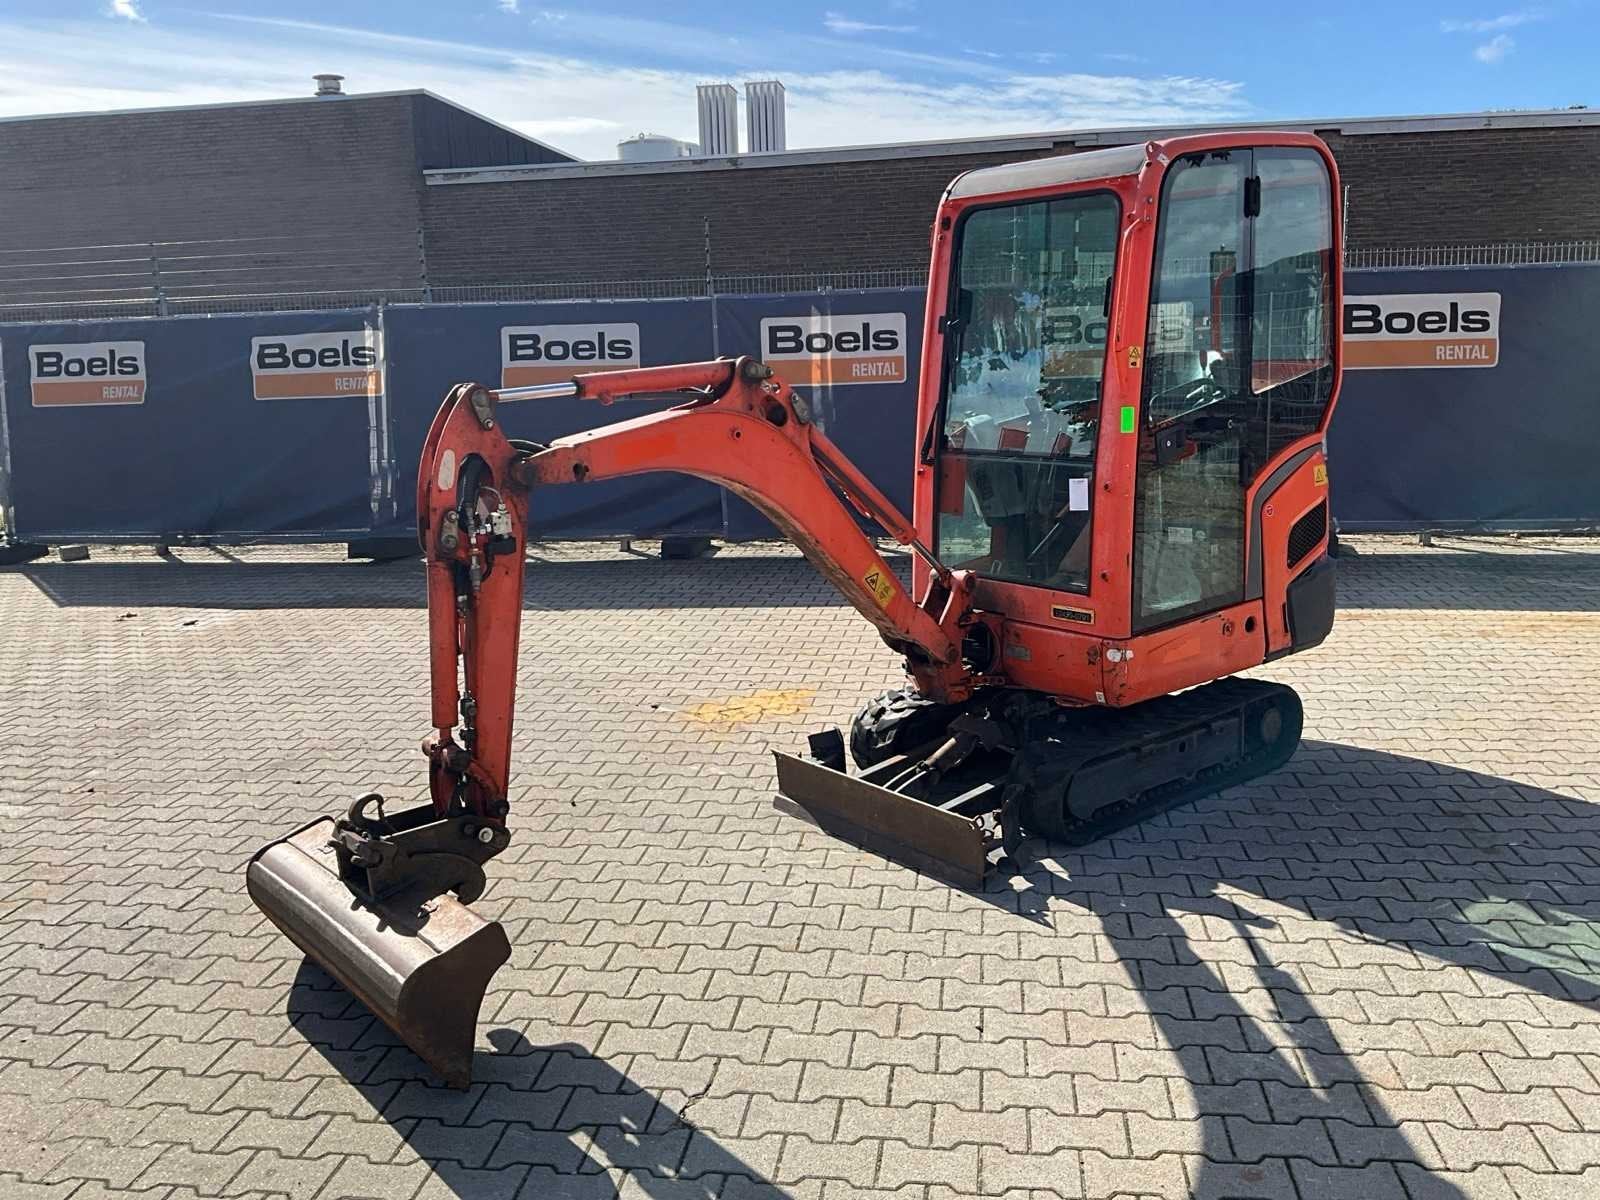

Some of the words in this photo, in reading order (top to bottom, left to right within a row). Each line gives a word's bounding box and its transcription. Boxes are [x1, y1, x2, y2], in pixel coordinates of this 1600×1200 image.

[1344, 302, 1491, 334] Boels
[509, 332, 633, 361] Boels
[768, 322, 899, 354] Boels
[36, 350, 140, 377] Boels
[257, 340, 376, 369] Boels
[1436, 345, 1489, 360] RENTAL
[852, 362, 898, 377] RENTAL
[103, 386, 139, 400] RENTAL
